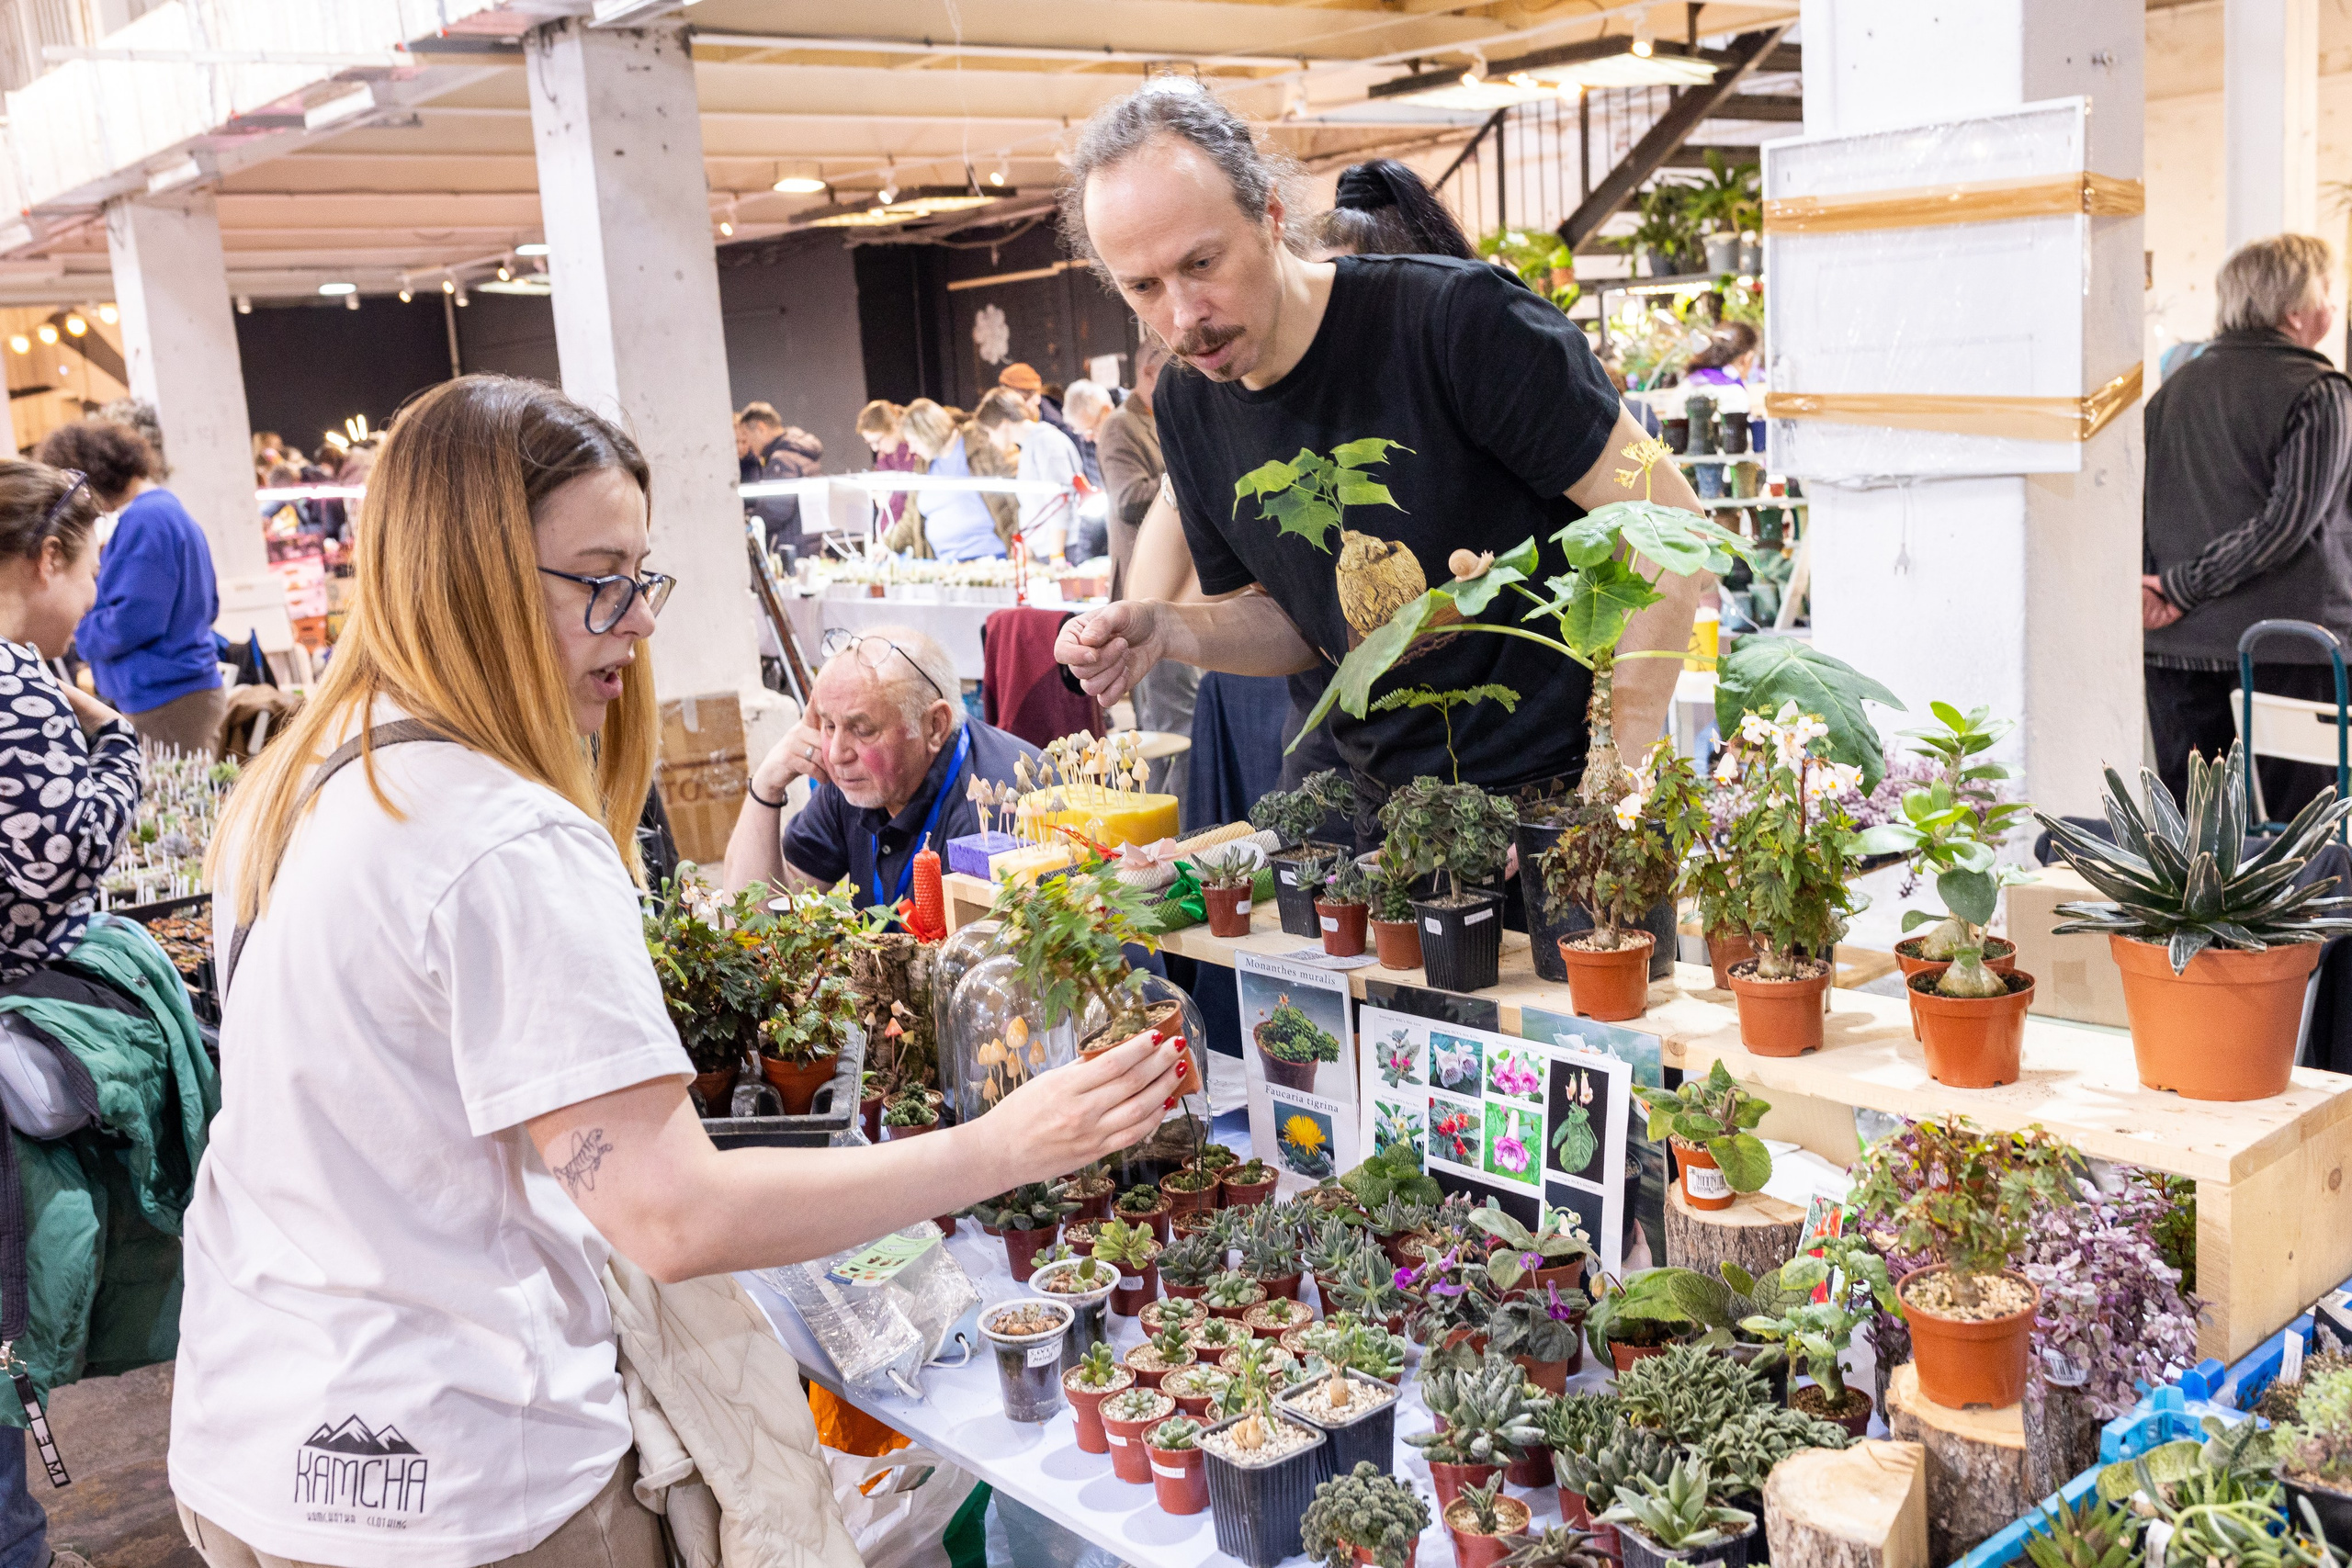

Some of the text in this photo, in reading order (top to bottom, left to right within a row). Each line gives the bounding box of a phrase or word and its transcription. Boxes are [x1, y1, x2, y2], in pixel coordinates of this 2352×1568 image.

[1246, 958, 1336, 986] Monanthes muralis
[1265, 1085, 1339, 1113] Faucaria tigrina
[294, 1450, 428, 1514] KAMCHA
[367, 1516, 407, 1529] CLOTHING
